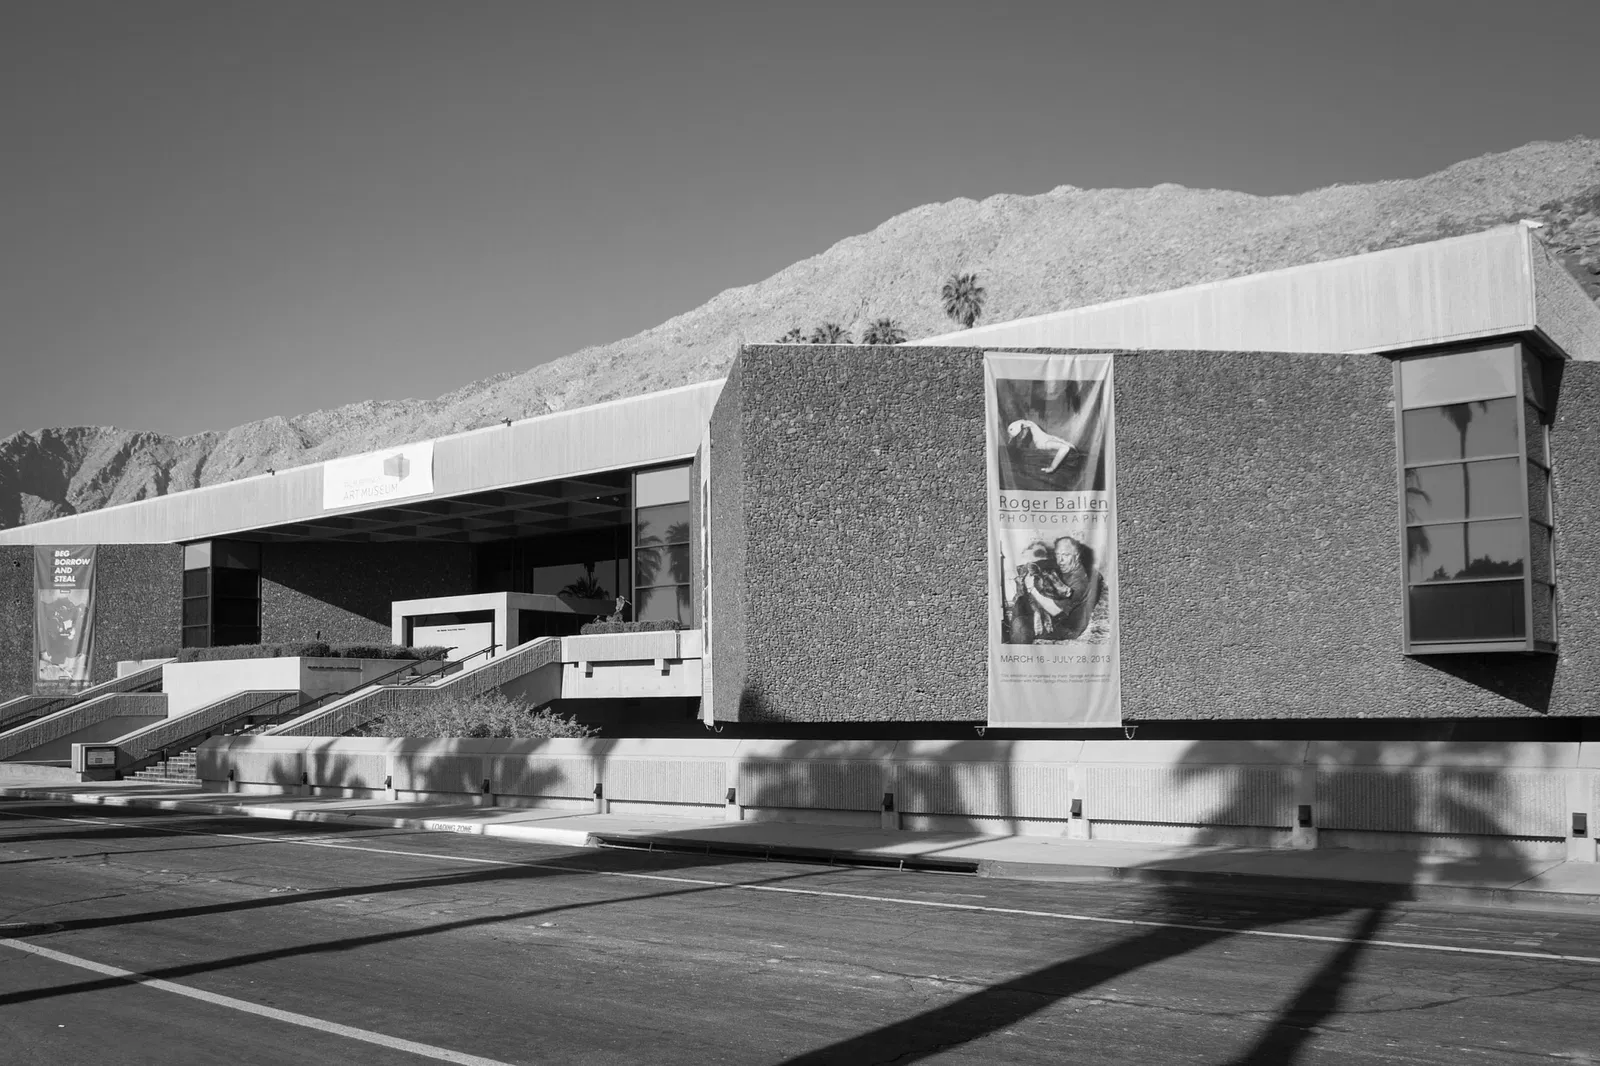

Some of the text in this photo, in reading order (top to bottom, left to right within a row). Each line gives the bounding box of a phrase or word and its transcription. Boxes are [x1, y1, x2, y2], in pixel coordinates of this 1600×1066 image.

[343, 483, 398, 500] ART MUSEUM
[999, 495, 1108, 512] Roger Ballen
[999, 513, 1109, 524] PHOTOGRAPHY
[54, 558, 91, 566] BORROW
[54, 575, 76, 583] STEAL
[1000, 655, 1034, 663] MARCH
[1036, 655, 1045, 664] 16
[1052, 655, 1074, 664] JULY
[1076, 655, 1089, 664] 28,
[1091, 655, 1111, 663] 2013
[432, 823, 456, 831] LOADING
